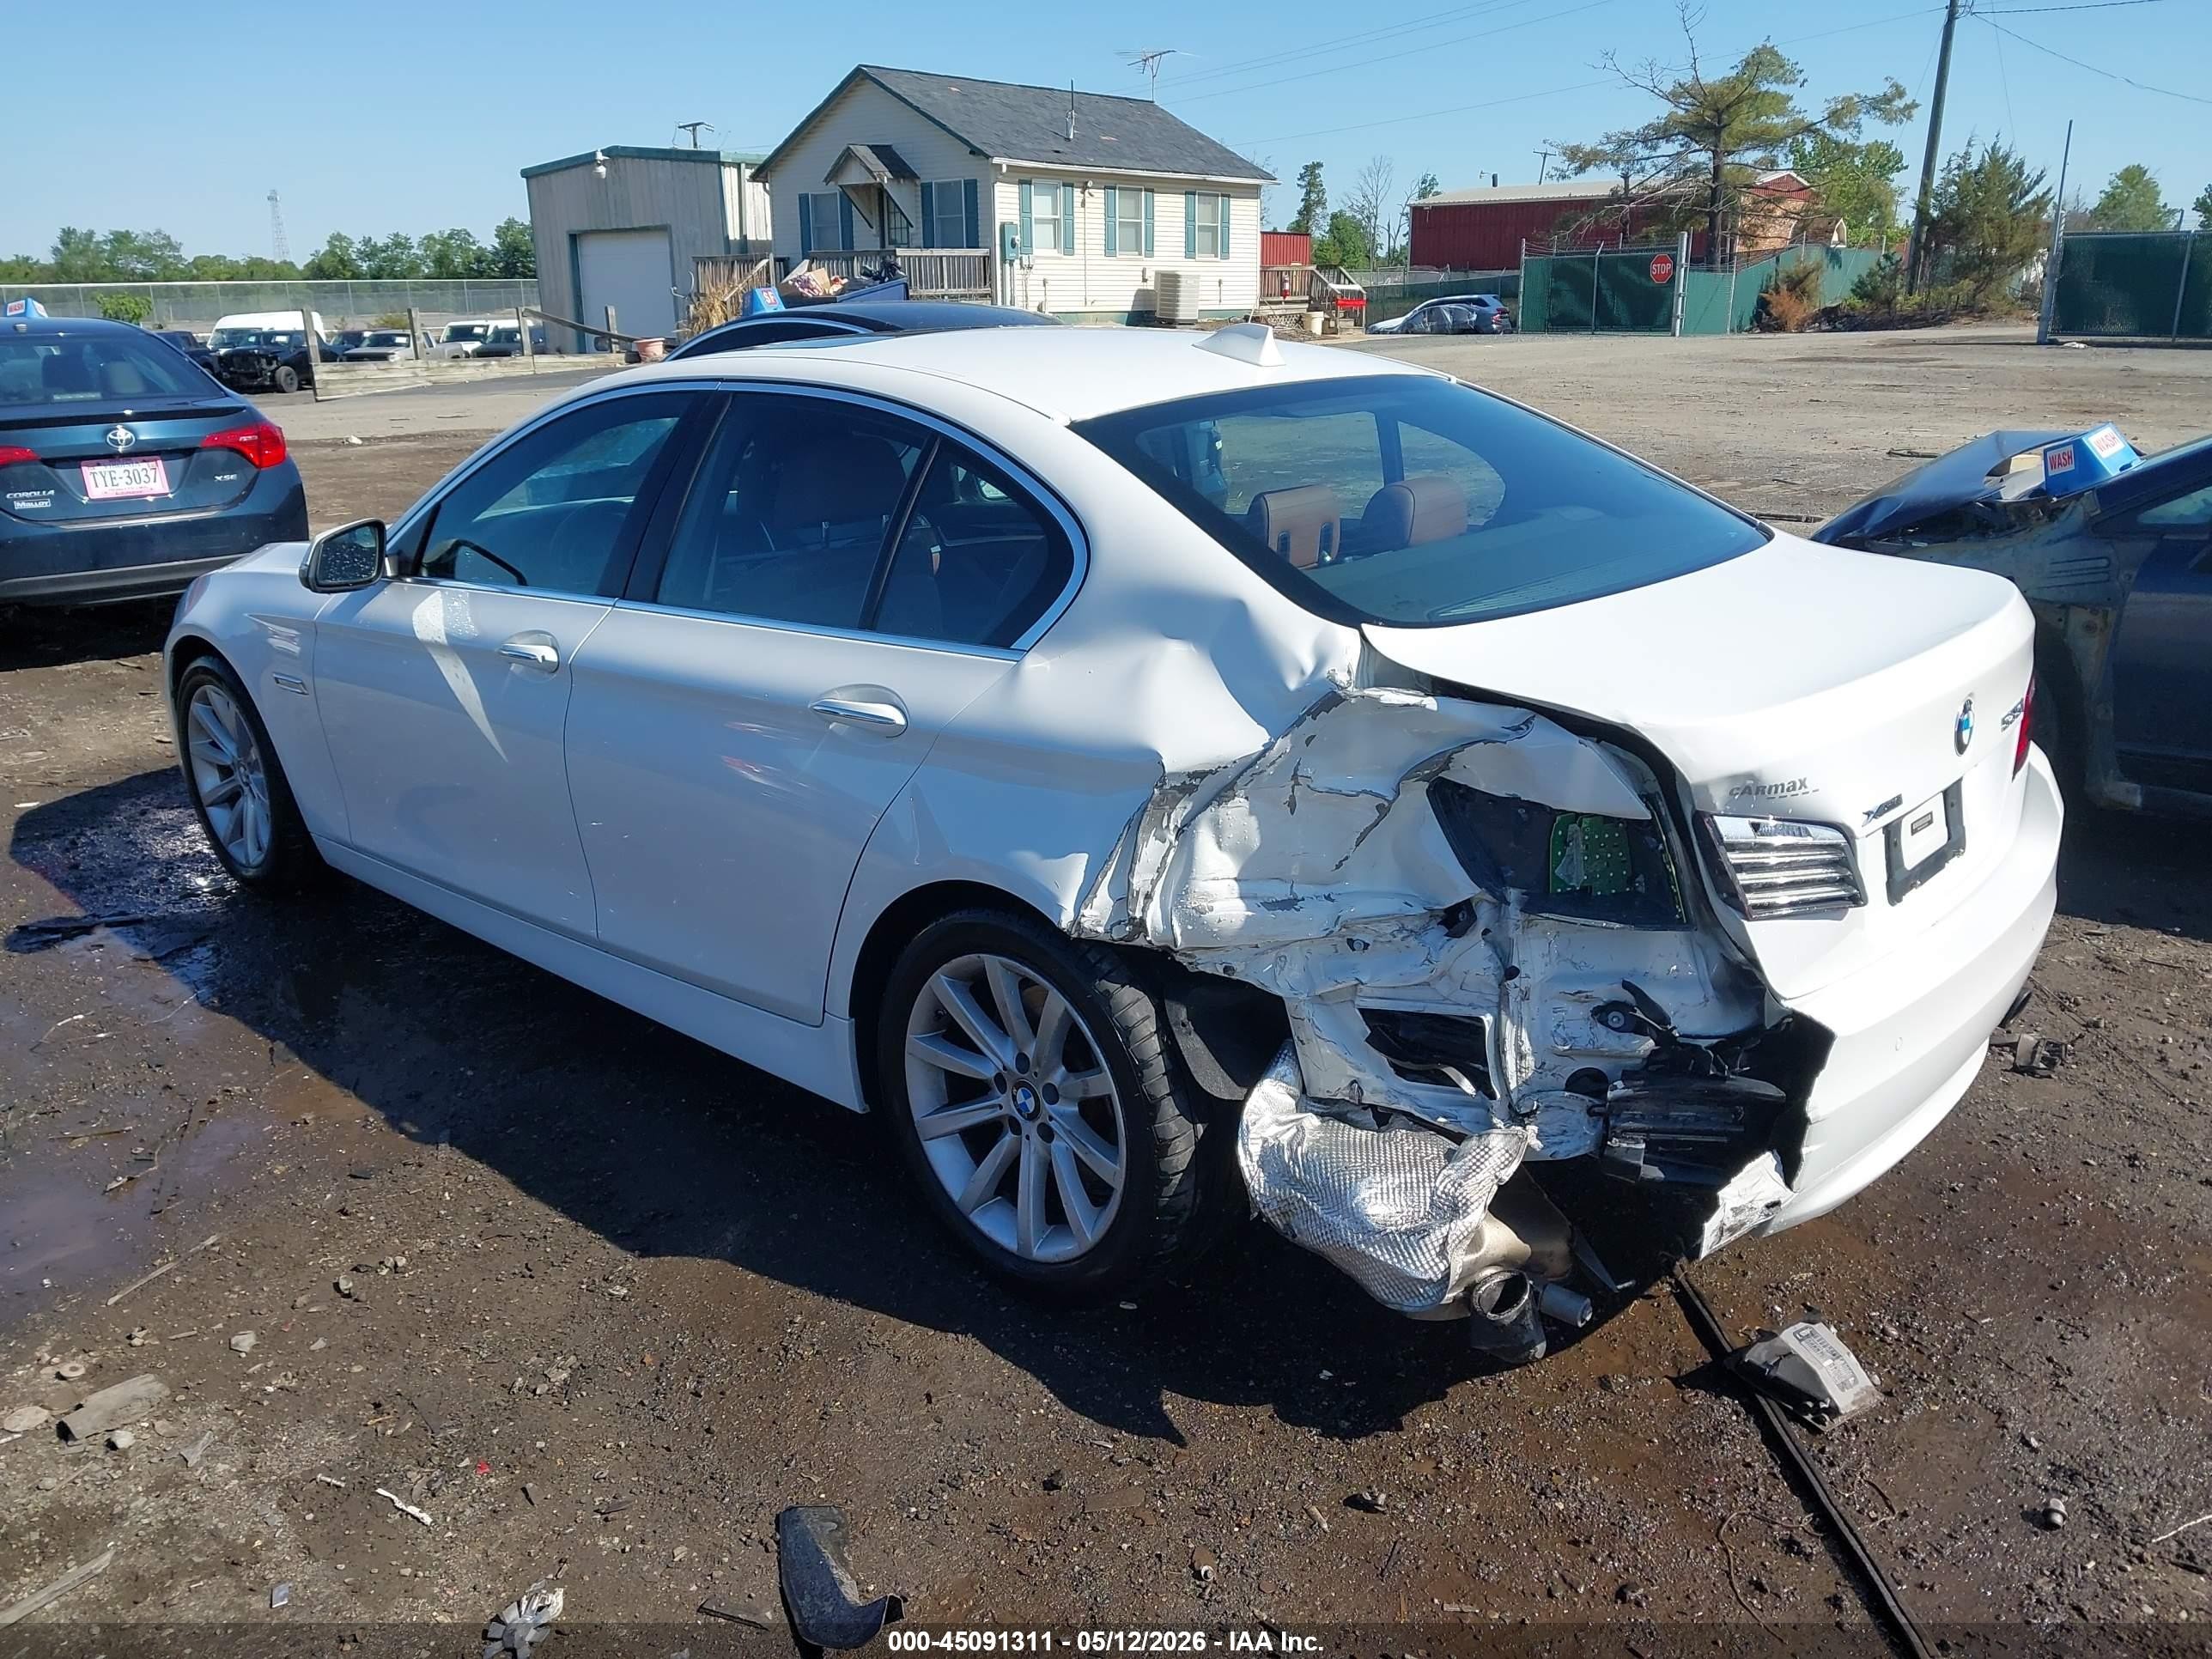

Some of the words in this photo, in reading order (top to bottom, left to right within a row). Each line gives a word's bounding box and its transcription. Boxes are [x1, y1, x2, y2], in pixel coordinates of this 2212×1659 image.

[1651, 263, 1672, 275] STOP
[2094, 432, 2120, 453] WASH
[2049, 448, 2074, 471] WASH
[89, 468, 157, 489] TYE-3037
[6, 490, 55, 499] COROLLA
